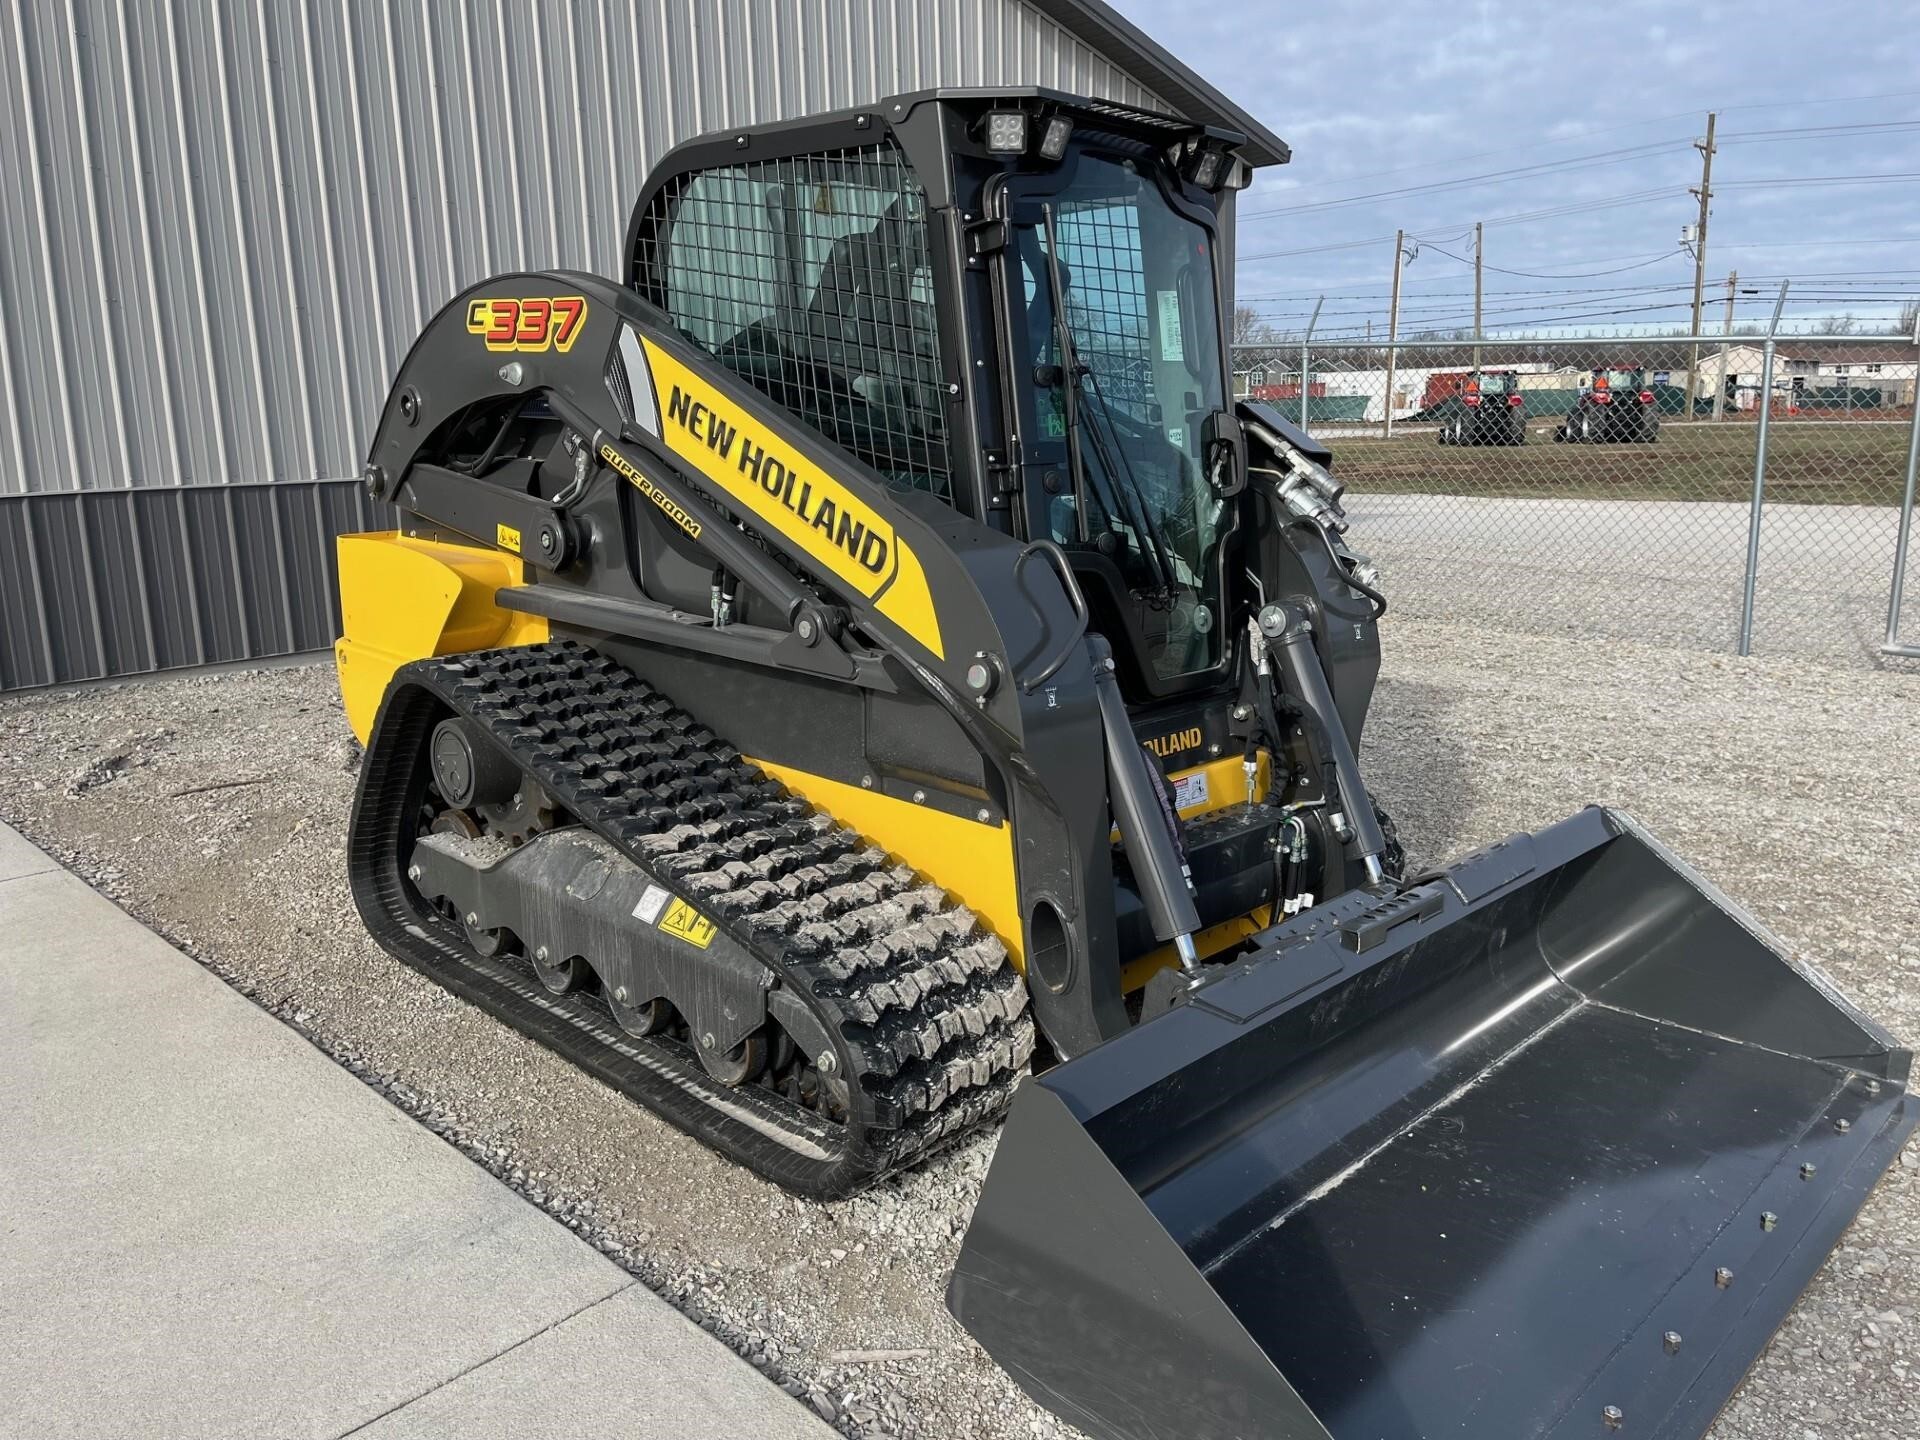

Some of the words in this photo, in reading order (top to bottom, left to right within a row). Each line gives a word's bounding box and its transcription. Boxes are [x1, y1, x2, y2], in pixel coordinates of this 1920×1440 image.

[467, 297, 587, 352] C337
[601, 445, 653, 497] SUPER
[651, 488, 702, 539] BOOM
[668, 384, 737, 459] NEW
[738, 437, 888, 573] HOLLAND
